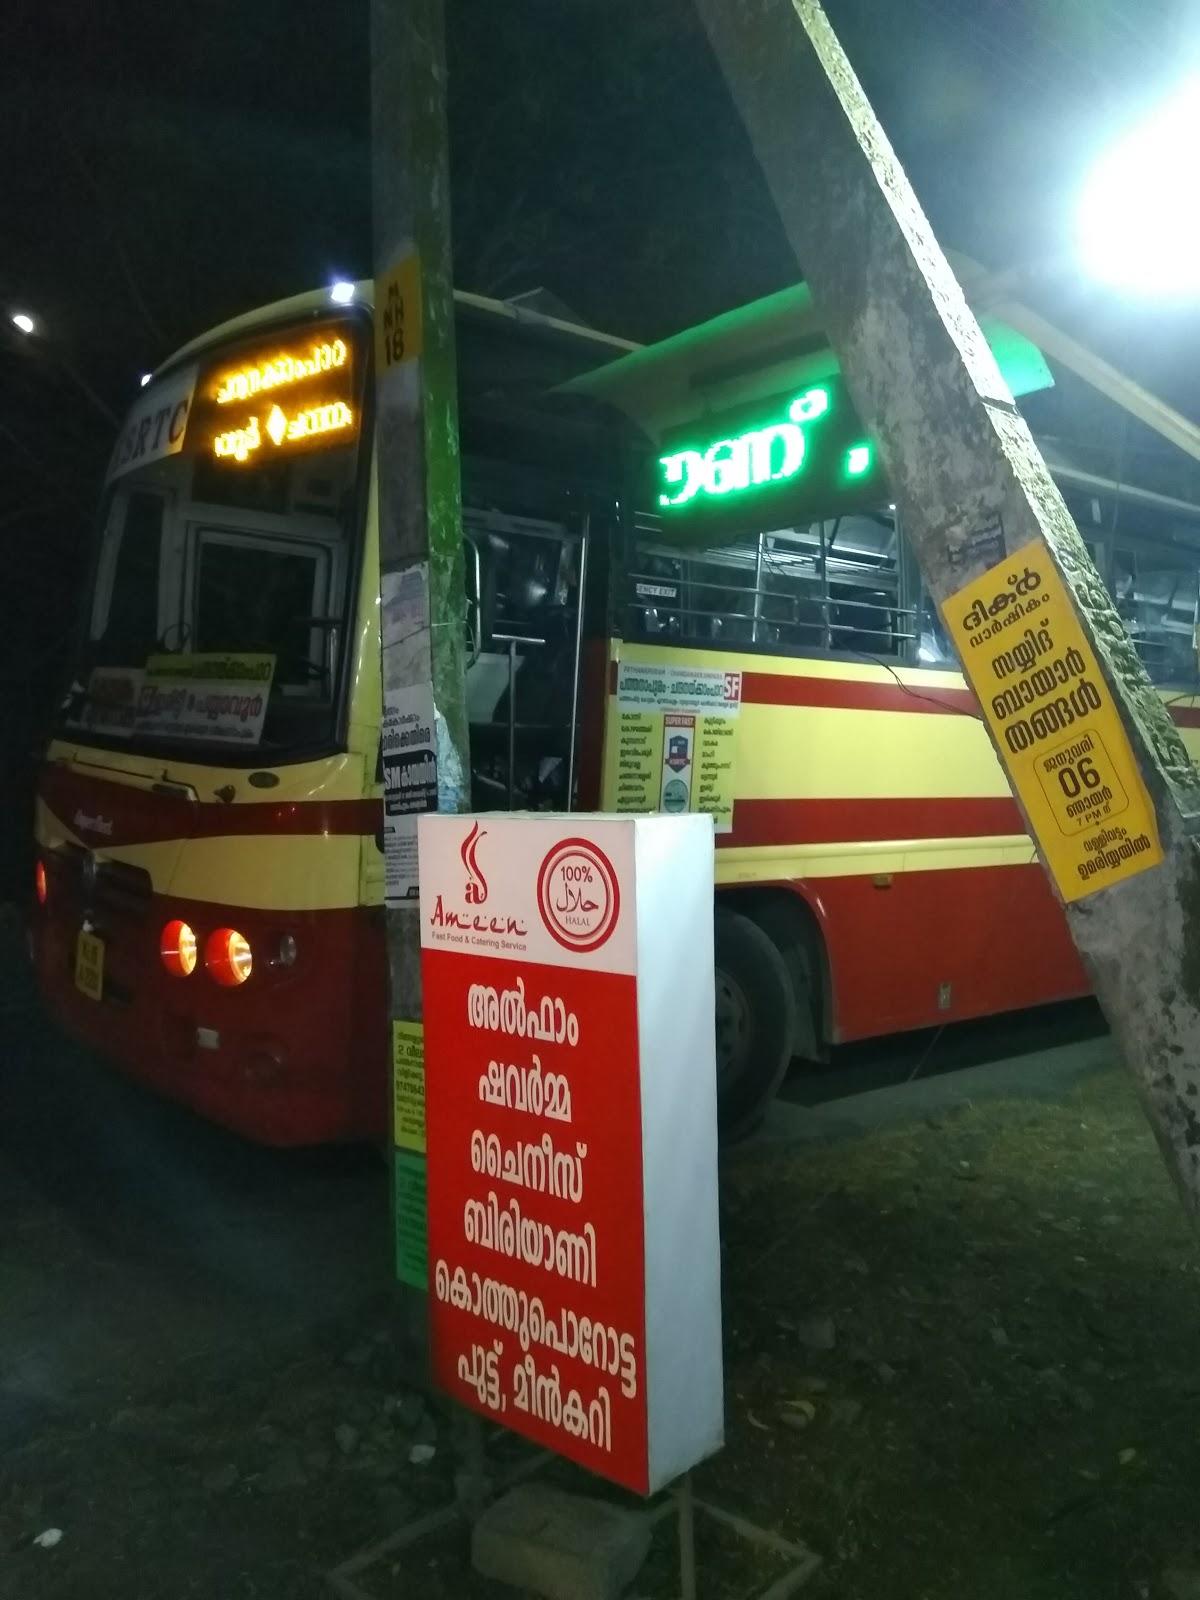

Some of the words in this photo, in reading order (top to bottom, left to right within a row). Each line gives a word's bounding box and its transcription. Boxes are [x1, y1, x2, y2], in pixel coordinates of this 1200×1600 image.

[969, 593, 1050, 648] വാർഷികം
[991, 618, 1054, 680] സയ്യിദ്
[724, 676, 739, 699] SF
[991, 647, 1086, 720] ബായാർ
[1004, 678, 1102, 753] തങ്ങൾ
[1043, 734, 1095, 772] ജനുവരി
[1058, 757, 1100, 798] 06
[1066, 785, 1113, 818] ഞായർ
[1085, 809, 1102, 823] PM
[556, 883, 599, 912] حلال
[560, 866, 593, 883] 100%
[430, 895, 528, 936] Ameen
[565, 915, 590, 926] HALAL
[432, 931, 446, 941] Fast
[447, 934, 463, 943] Food
[464, 936, 469, 944] &
[471, 937, 499, 950] Catering
[501, 940, 527, 951] Service
[467, 976, 579, 1047] അൽഫാം
[478, 1054, 572, 1123] ഷവർമ്മ
[471, 1129, 588, 1203] ചൈനീസ്
[464, 1191, 597, 1288] ബിരിയാണി
[435, 1259, 636, 1399] കൊത്തുപൊറോട്ട
[513, 1354, 612, 1452] മീൻകറി
